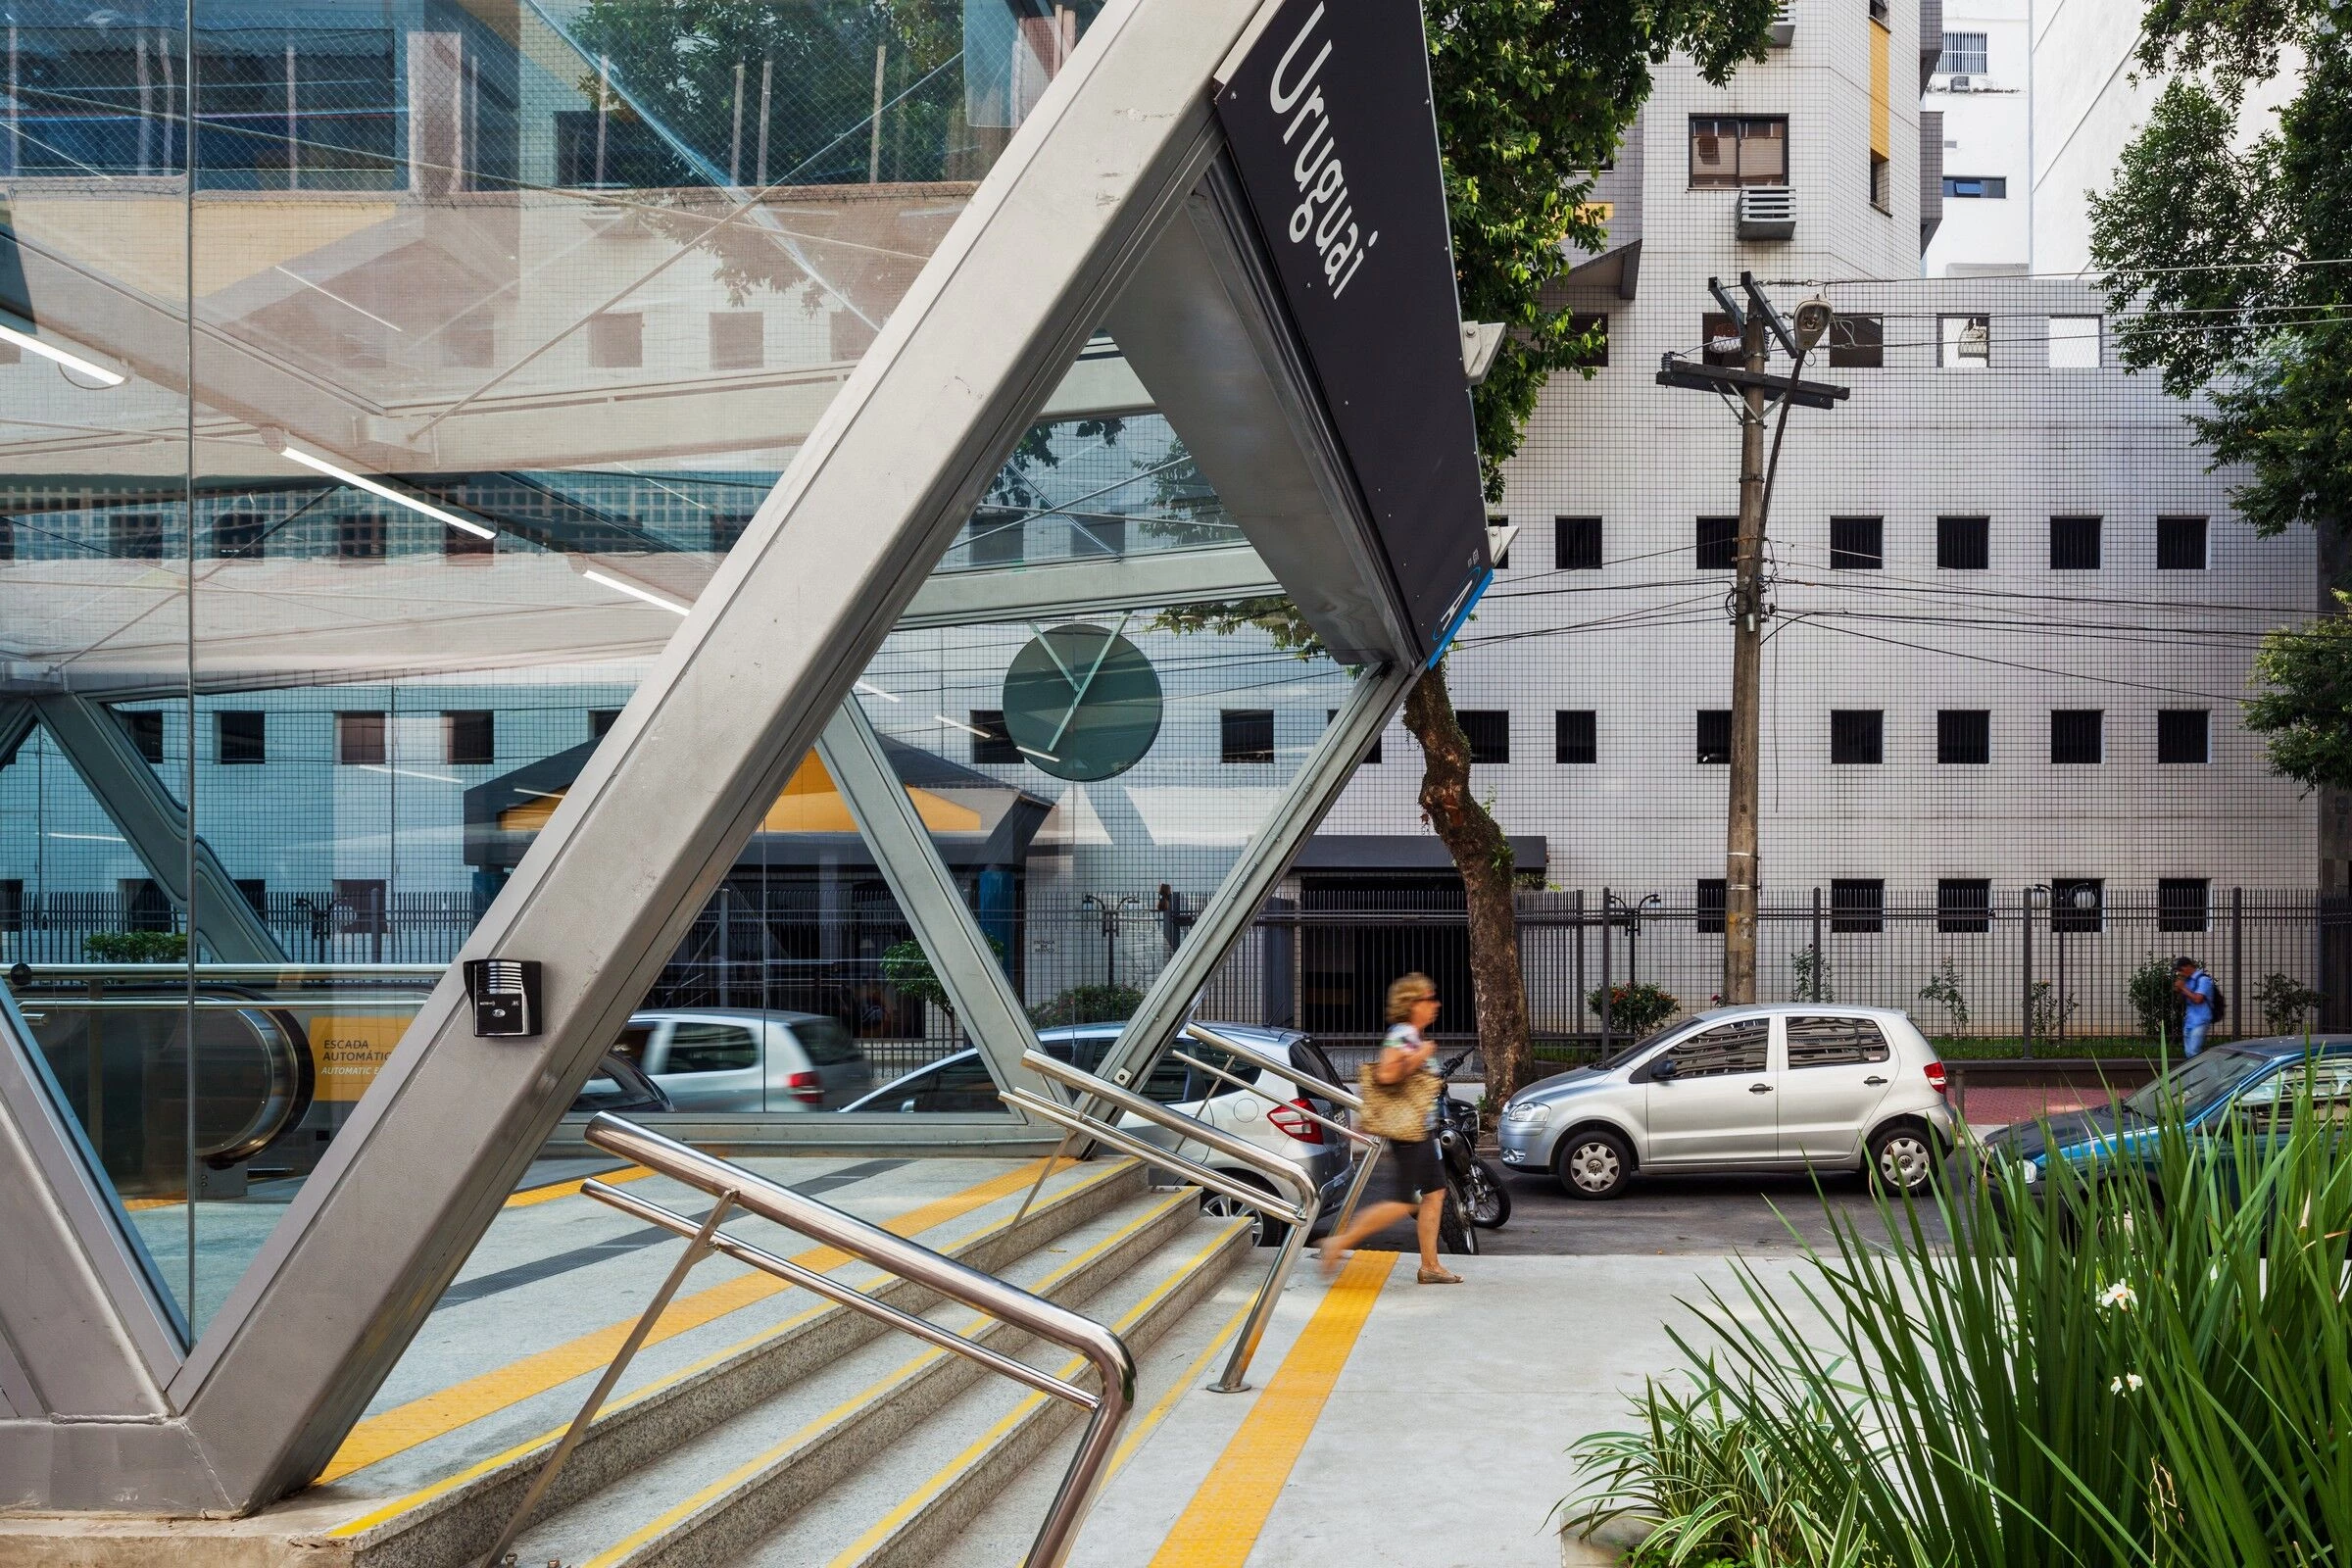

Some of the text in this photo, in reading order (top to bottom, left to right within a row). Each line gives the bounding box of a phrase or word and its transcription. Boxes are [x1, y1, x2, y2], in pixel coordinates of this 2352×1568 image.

[1270, 1, 1379, 299] Uruguai
[323, 1040, 369, 1050] ESCADA
[321, 1066, 371, 1075] AUTOMATIC
